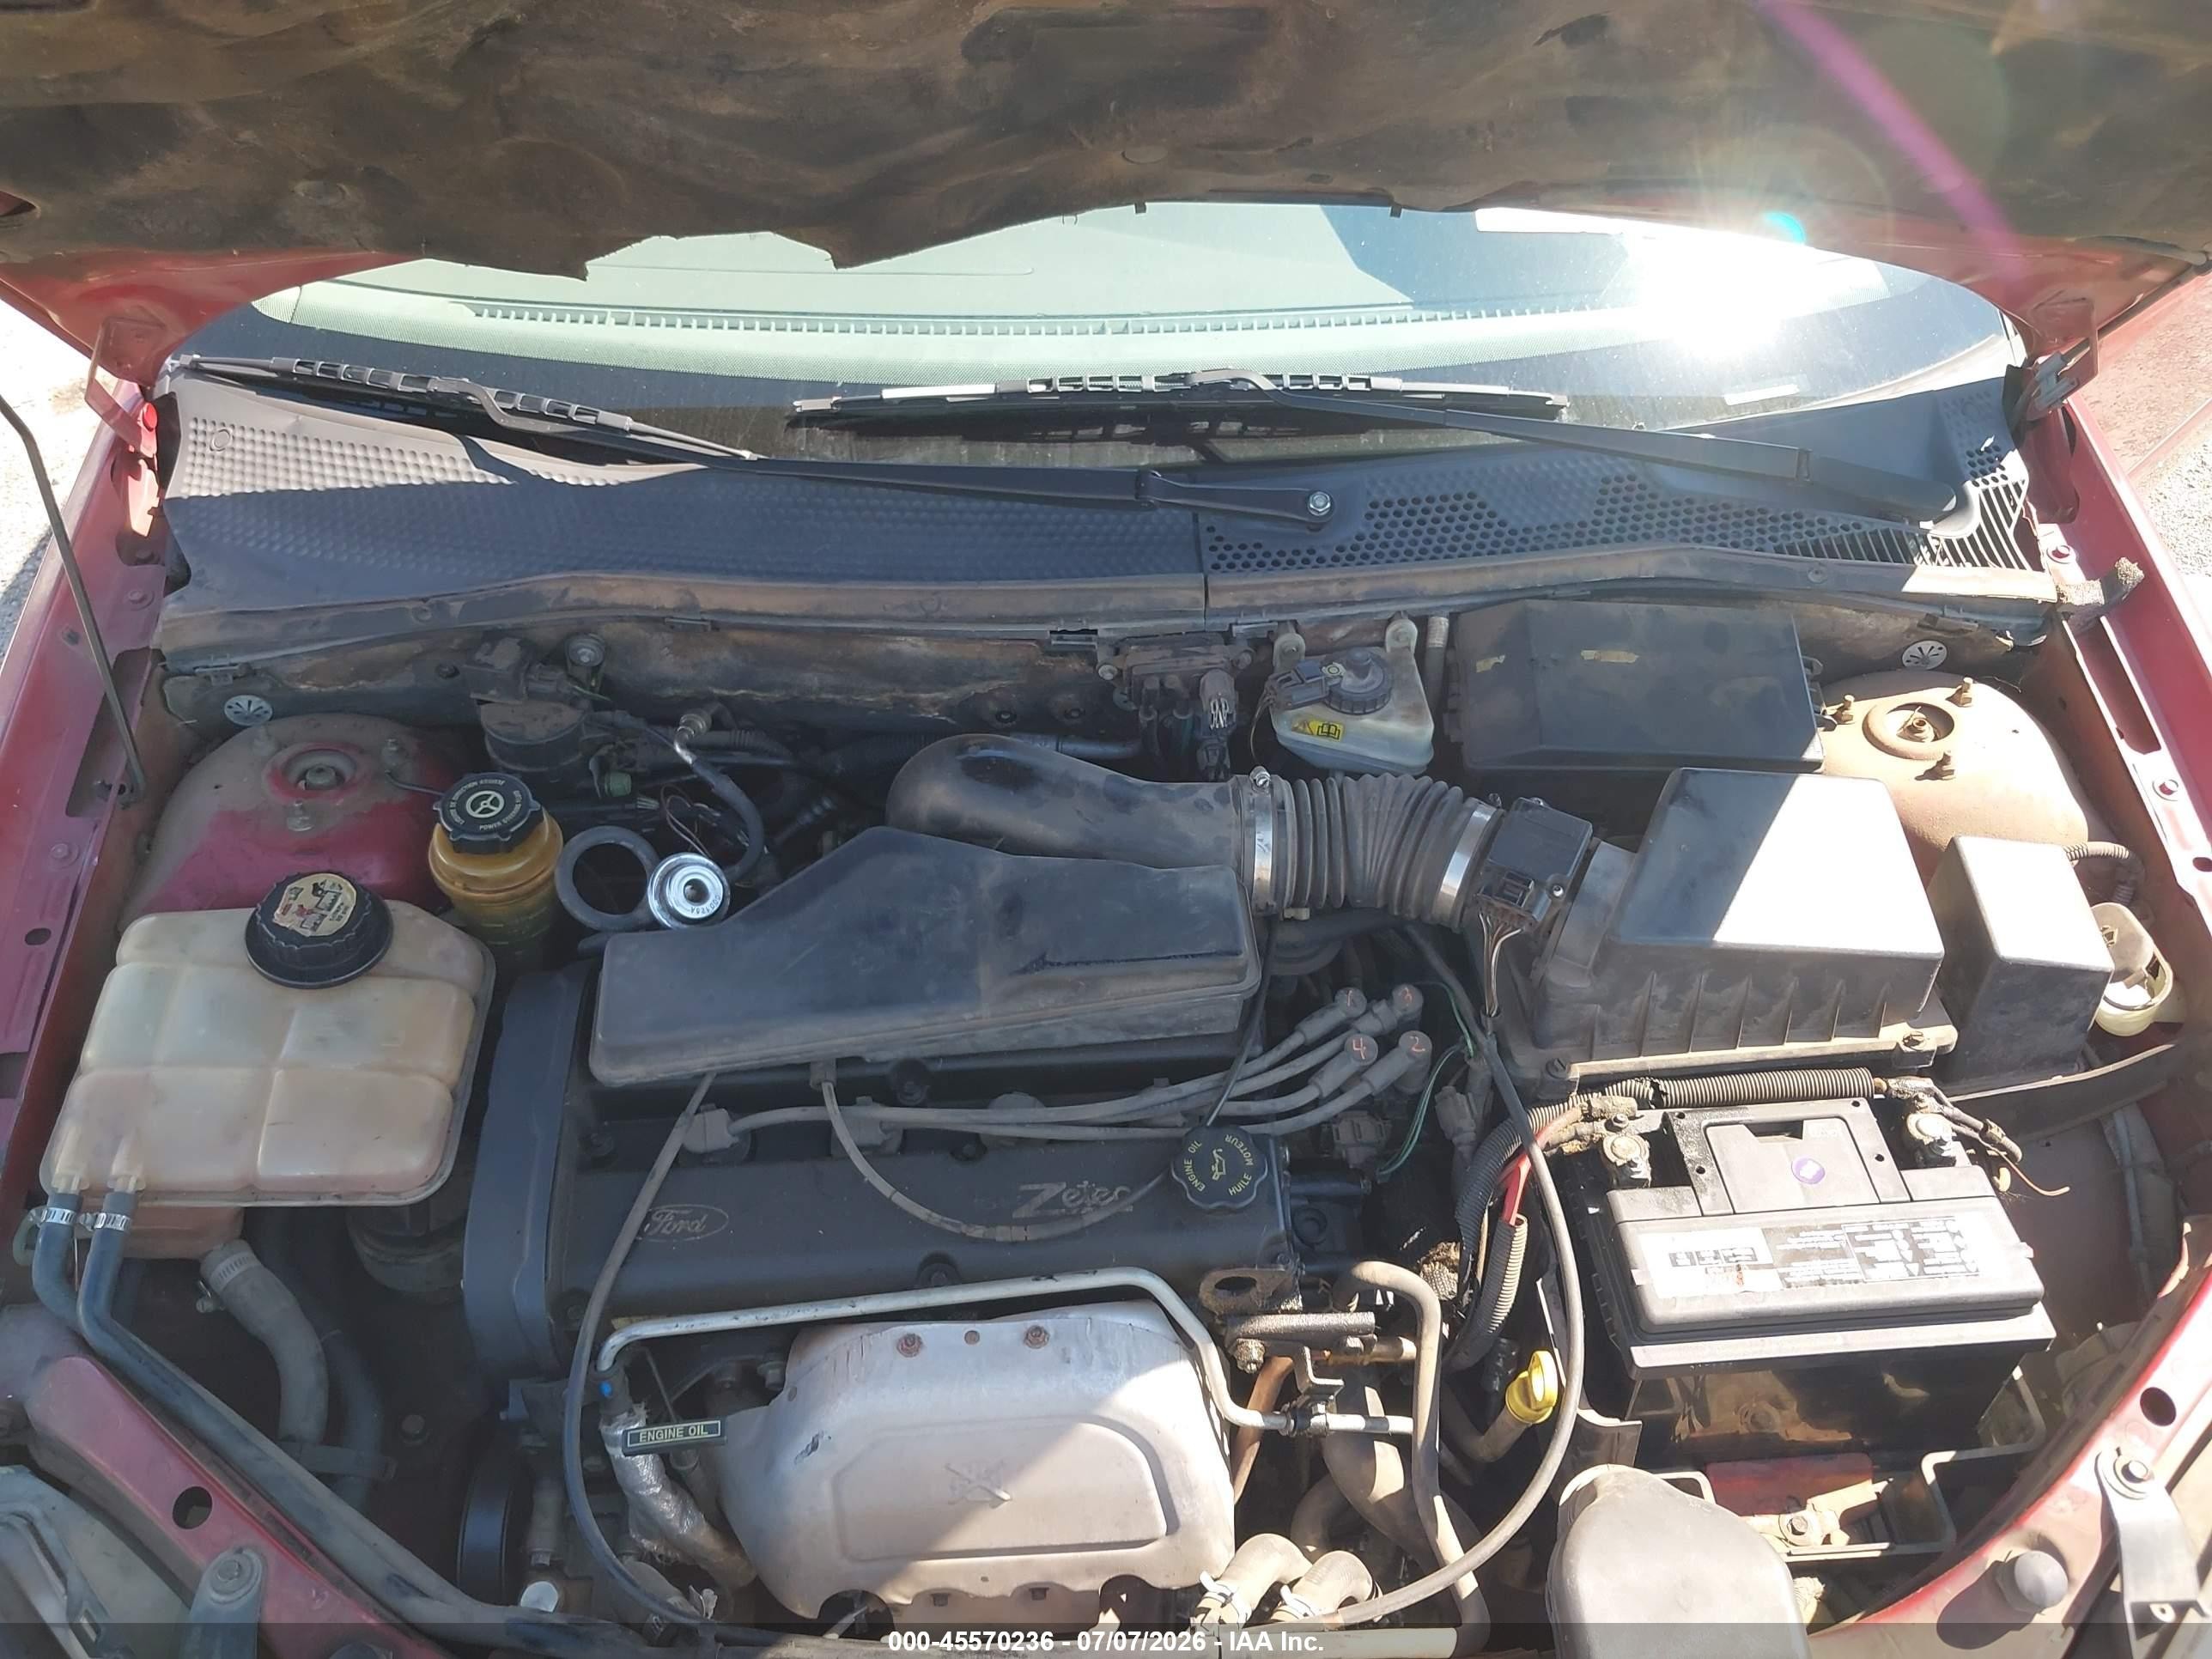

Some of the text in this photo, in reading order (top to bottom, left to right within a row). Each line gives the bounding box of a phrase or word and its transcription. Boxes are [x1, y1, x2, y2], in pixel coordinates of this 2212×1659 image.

[1352, 1037, 1366, 1060] 4
[1410, 1036, 1426, 1053] 2
[1184, 1140, 1206, 1192] ENGINE OIL
[1224, 1134, 1254, 1195] HUILE MOTEUR
[647, 1208, 708, 1236] Ford
[639, 1425, 708, 1443] ENGINE OIL
